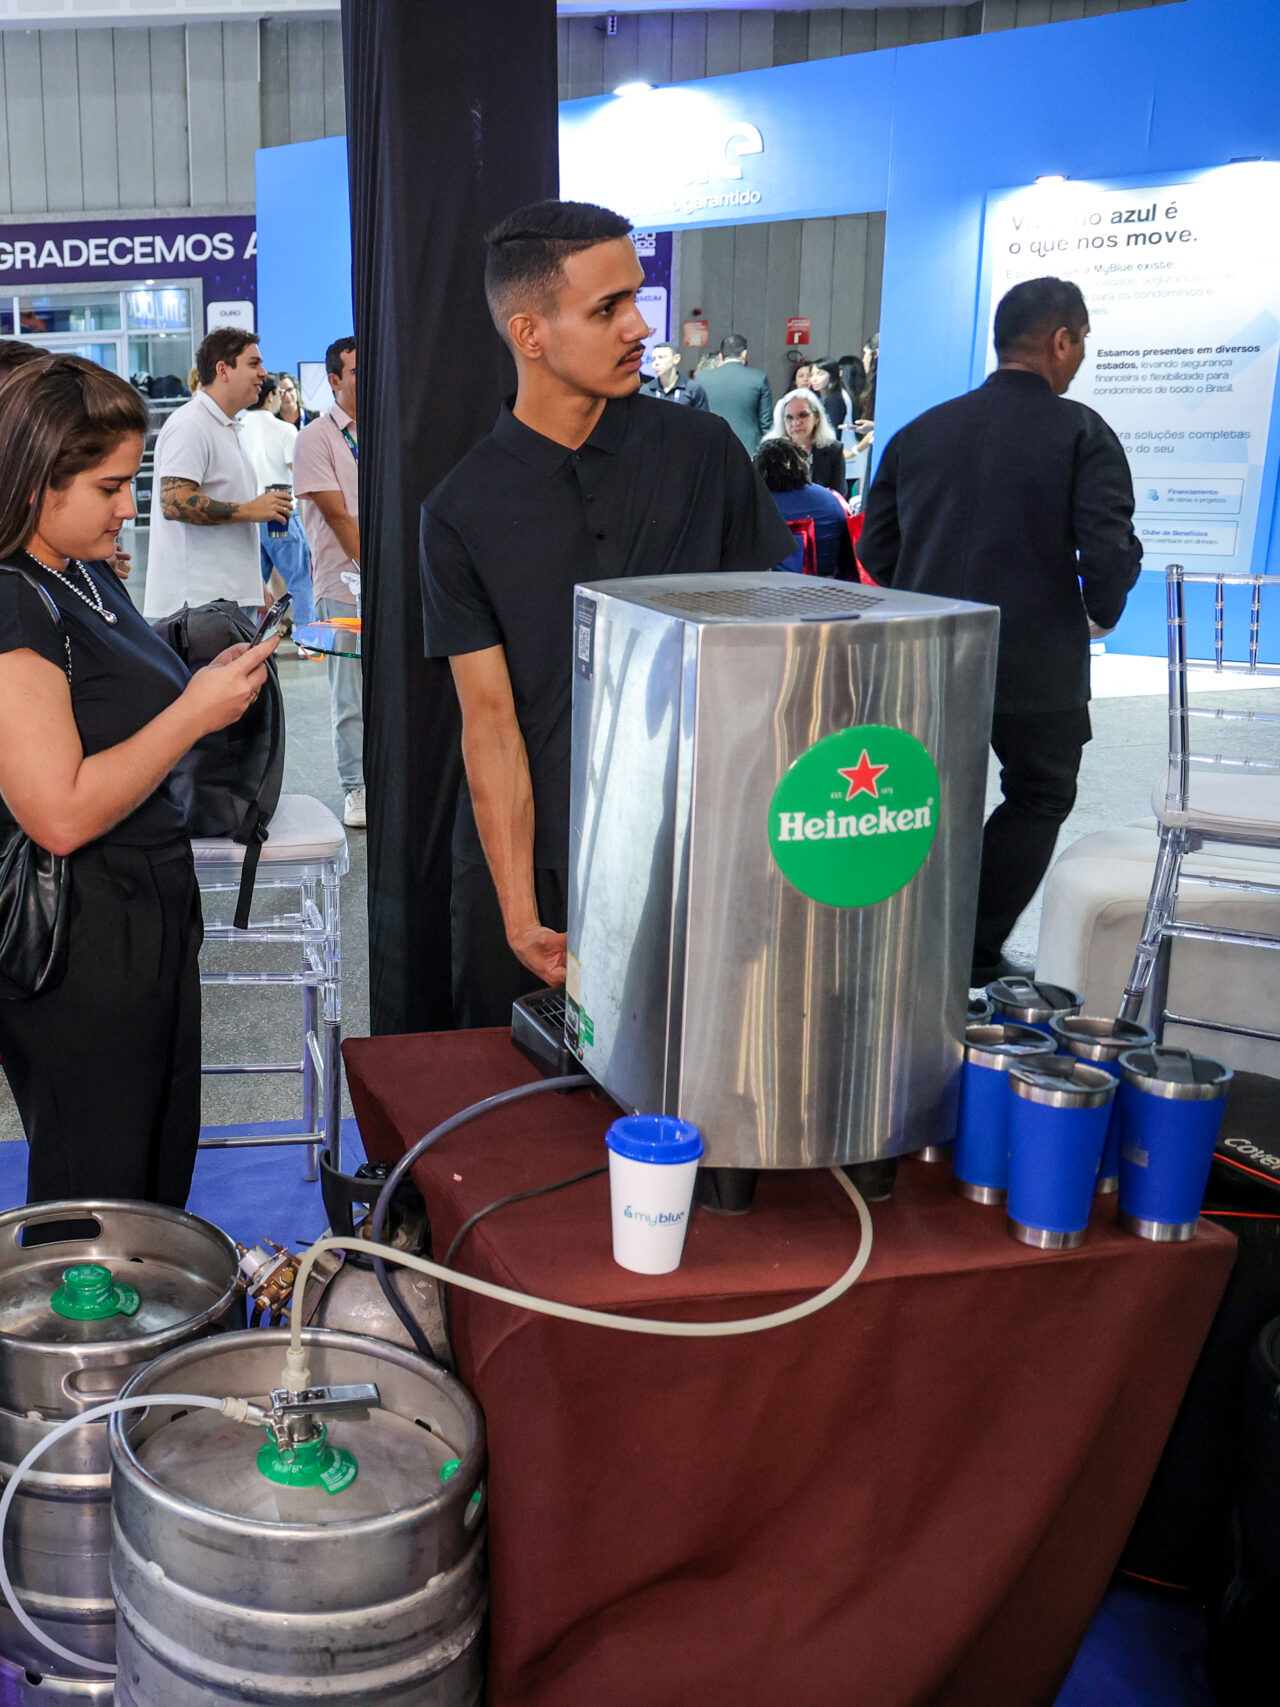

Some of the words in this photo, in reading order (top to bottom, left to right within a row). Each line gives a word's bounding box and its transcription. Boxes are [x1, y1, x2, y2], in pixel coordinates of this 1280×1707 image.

[683, 189, 762, 215] garantido
[1110, 203, 1157, 224] azul
[1165, 201, 1179, 219] é
[1009, 242, 1022, 255] o
[1030, 239, 1069, 258] que
[1077, 234, 1118, 250] nos
[1126, 229, 1198, 247] move.
[1094, 263, 1133, 275] MyBlue
[1097, 348, 1140, 358] Estamos
[1142, 347, 1194, 358] presentes
[1197, 347, 1212, 355] em
[1215, 345, 1261, 354] diversos
[1096, 361, 1139, 370] estados,
[1141, 360, 1178, 369] levando
[1181, 358, 1233, 370] segurança
[1095, 373, 1139, 383] financeira
[1150, 372, 1204, 381] flexibilidade
[1206, 372, 1230, 382] para
[1093, 386, 1152, 396] condomínios
[1155, 386, 1167, 394] de
[1169, 386, 1193, 394] todo
[1206, 384, 1233, 393] Brasil.
[1134, 430, 1185, 441] soluções
[1188, 430, 1252, 442] completas
[1136, 444, 1151, 453] do
[1153, 445, 1175, 454] seu
[777, 804, 932, 842] Heineken
[634, 1210, 685, 1227] myblue
